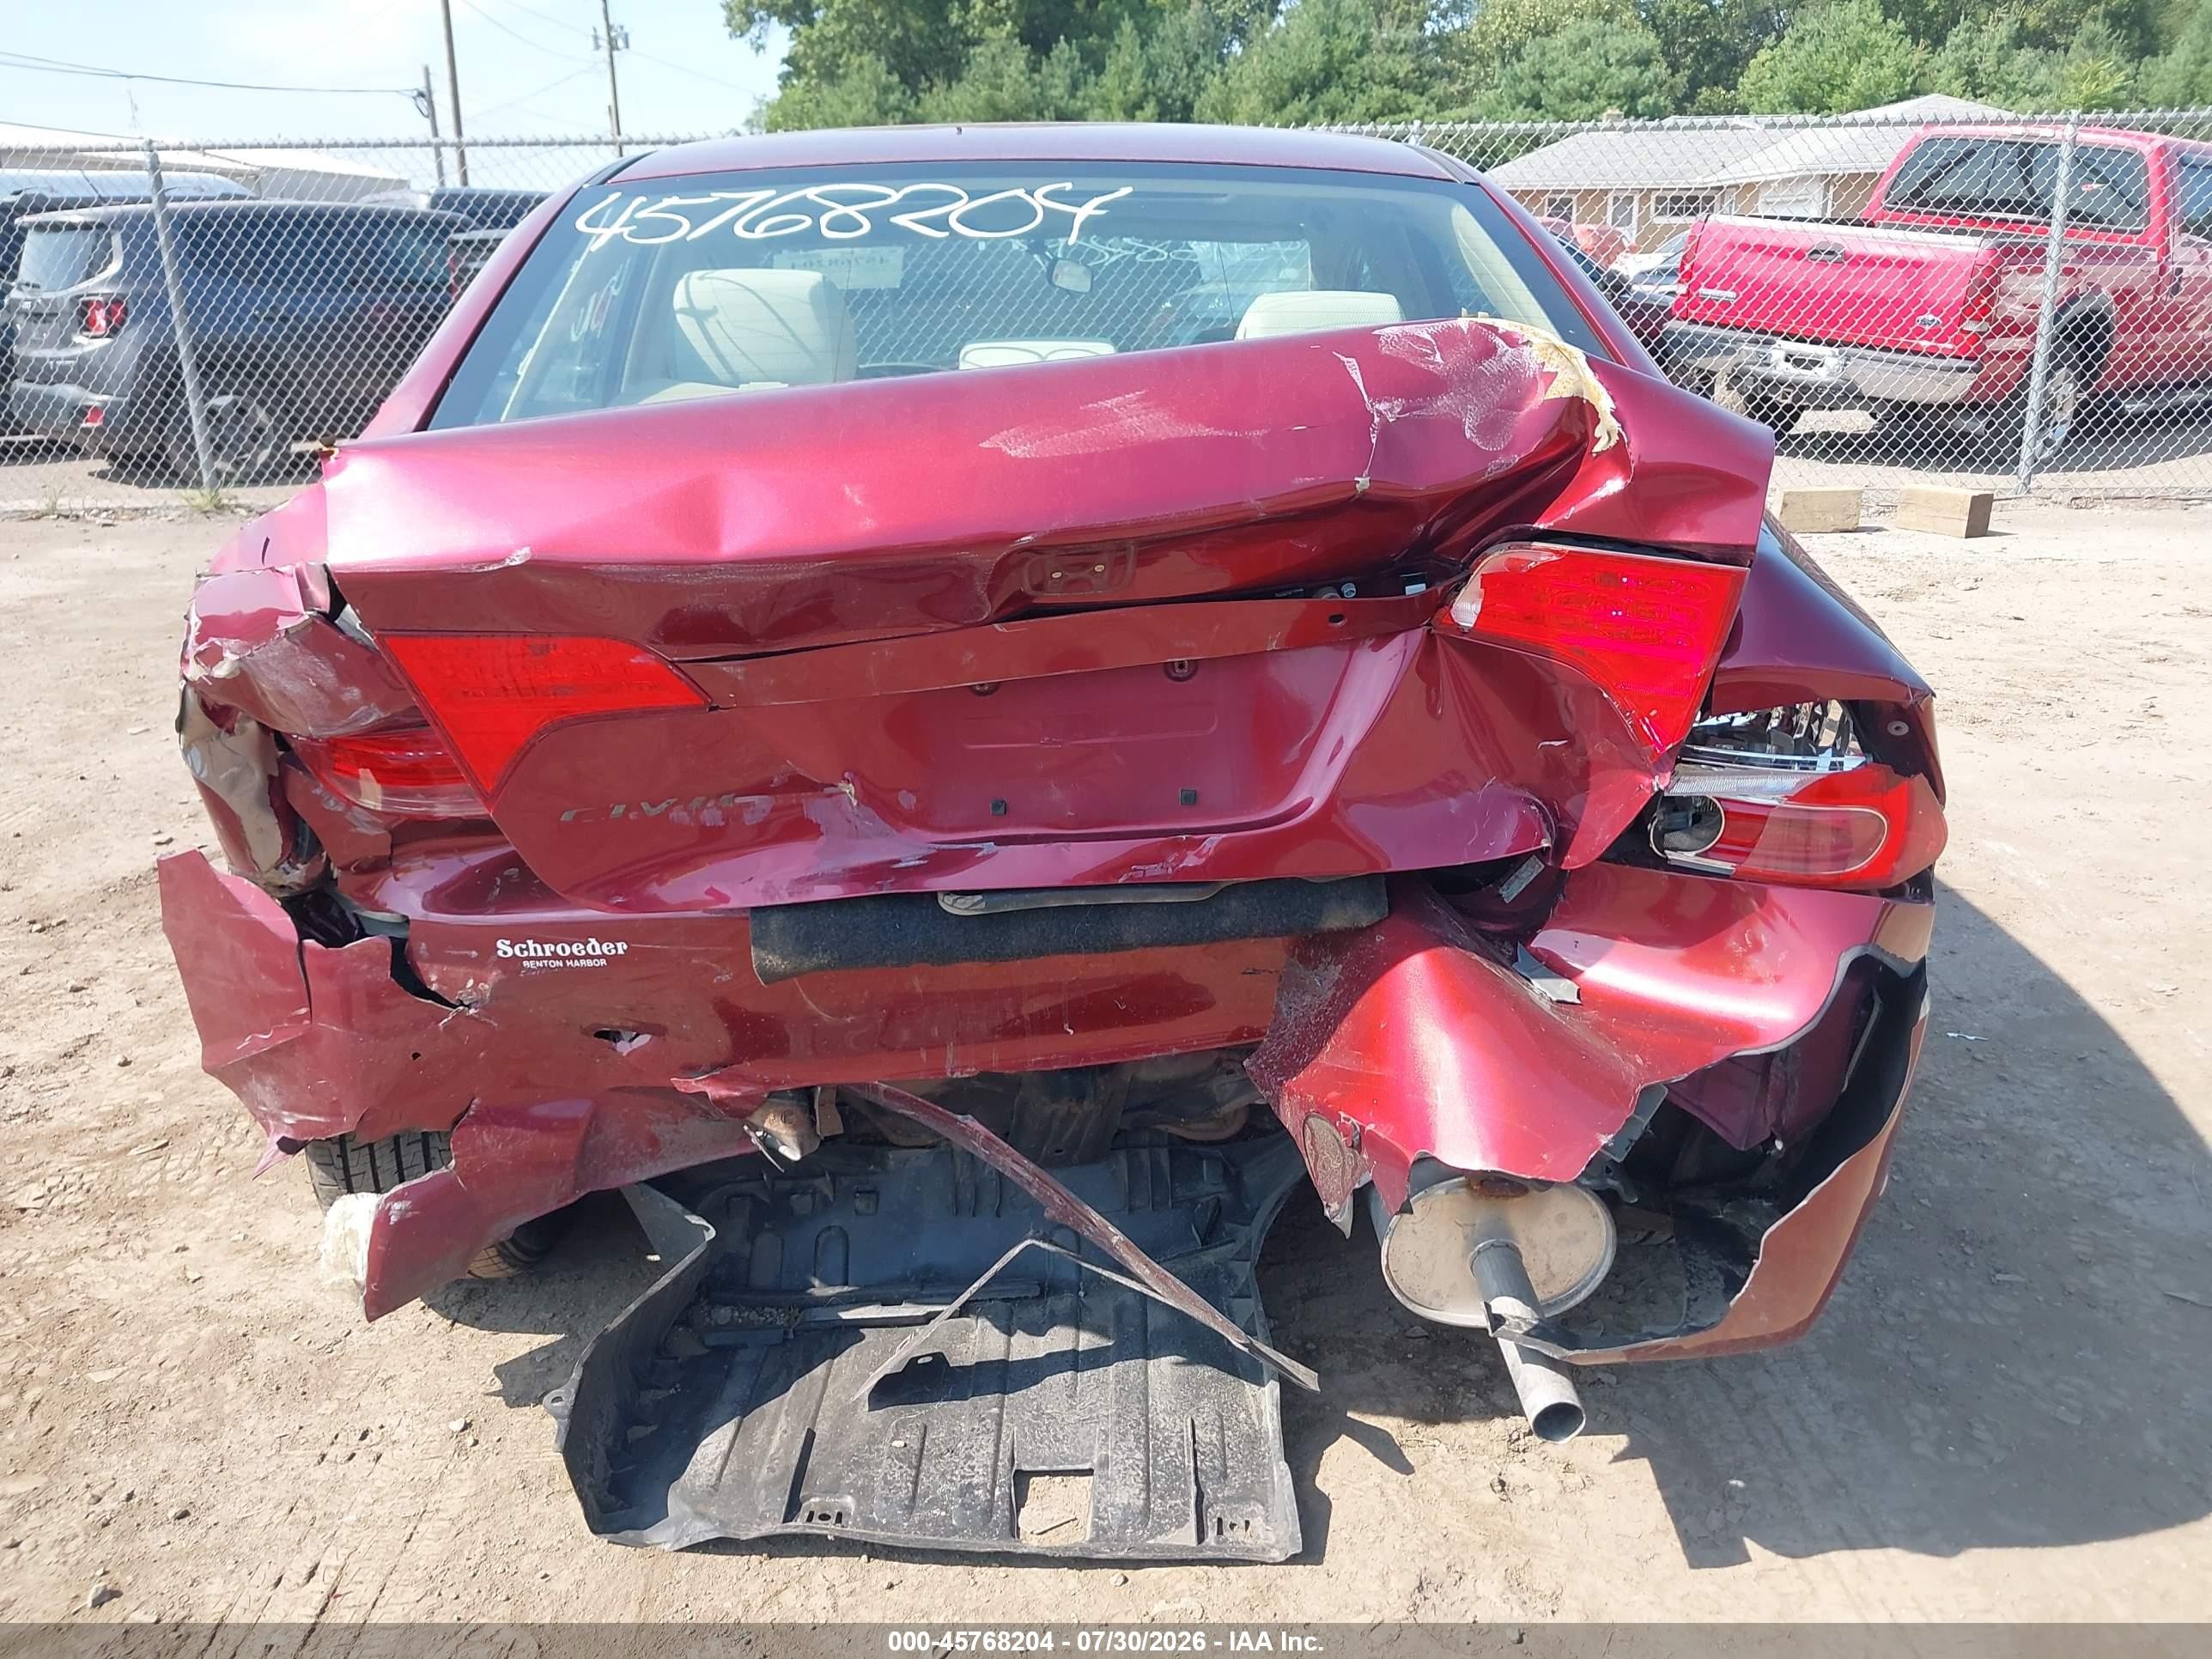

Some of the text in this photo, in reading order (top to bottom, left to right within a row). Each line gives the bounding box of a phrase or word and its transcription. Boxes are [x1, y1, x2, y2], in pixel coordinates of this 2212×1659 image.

[576, 182, 1134, 252] 45768204
[495, 938, 628, 958] Schroeder
[522, 958, 607, 969] BENTON HARBOR
